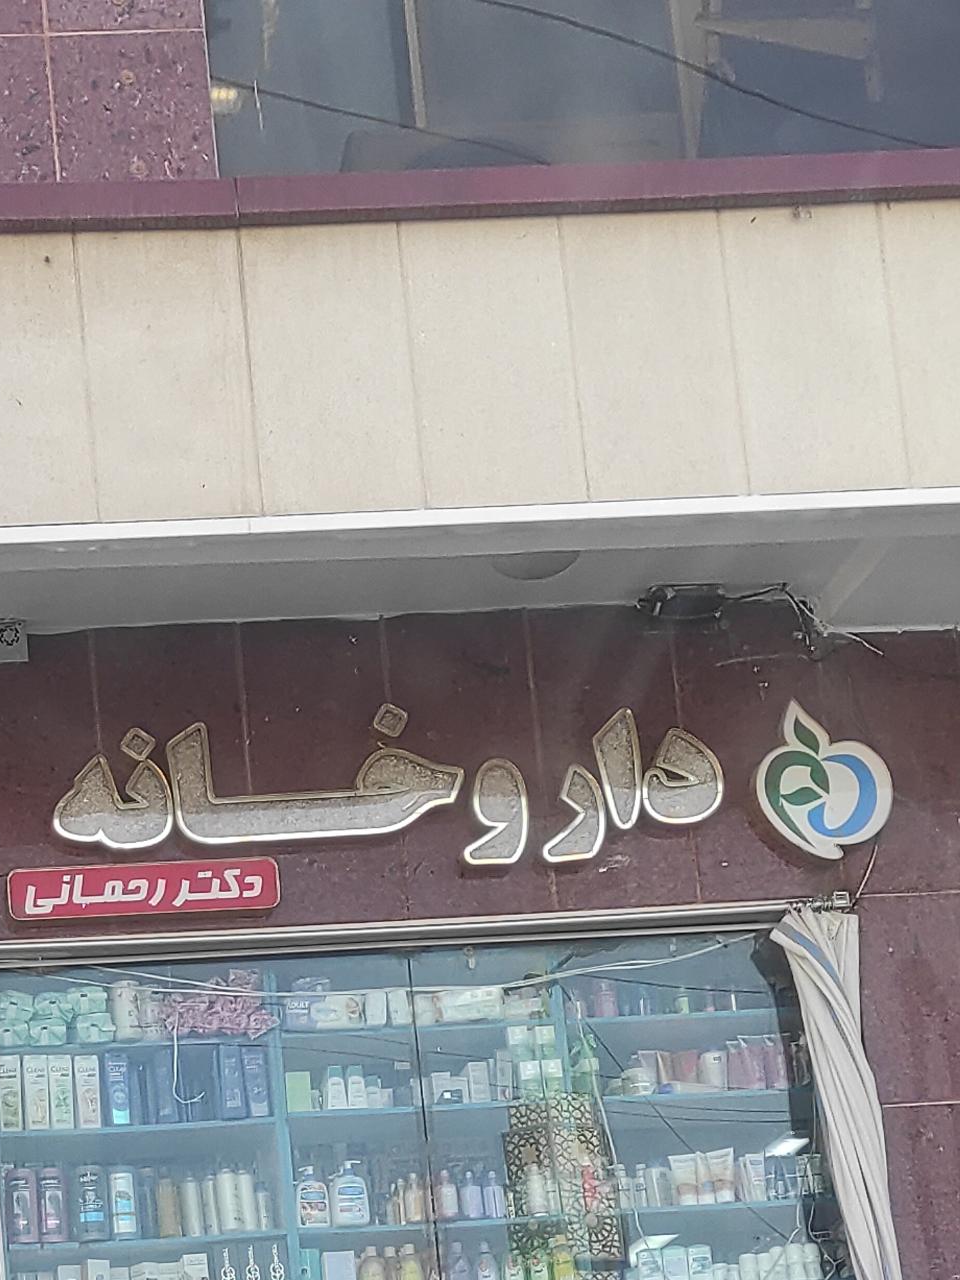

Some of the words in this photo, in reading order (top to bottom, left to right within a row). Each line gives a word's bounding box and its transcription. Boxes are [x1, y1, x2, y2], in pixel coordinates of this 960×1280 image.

[51, 702, 727, 866] داروخانه
[24, 874, 167, 915] رحمانی
[171, 868, 264, 907] دکتر
